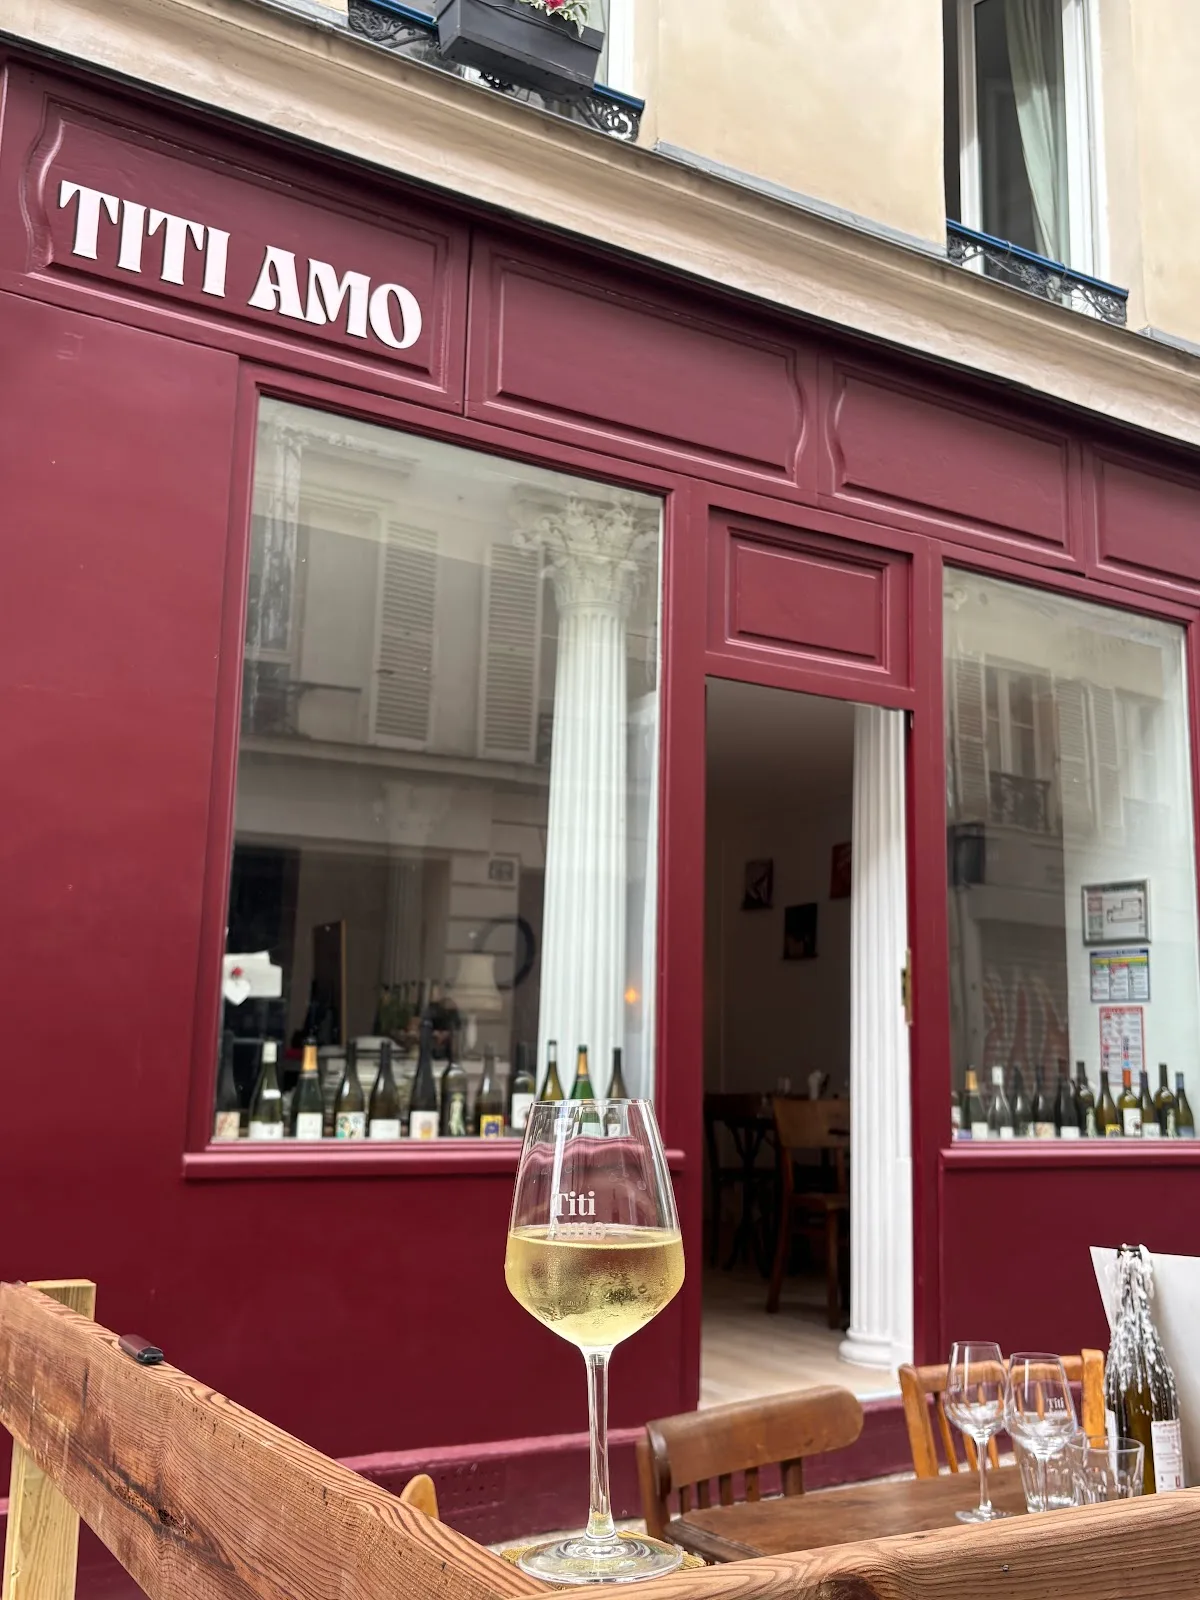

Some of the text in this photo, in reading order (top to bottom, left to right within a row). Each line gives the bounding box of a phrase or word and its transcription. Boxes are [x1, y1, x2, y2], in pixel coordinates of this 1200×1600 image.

[59, 180, 422, 349] TITI AMO
[551, 1190, 596, 1216] Titi
